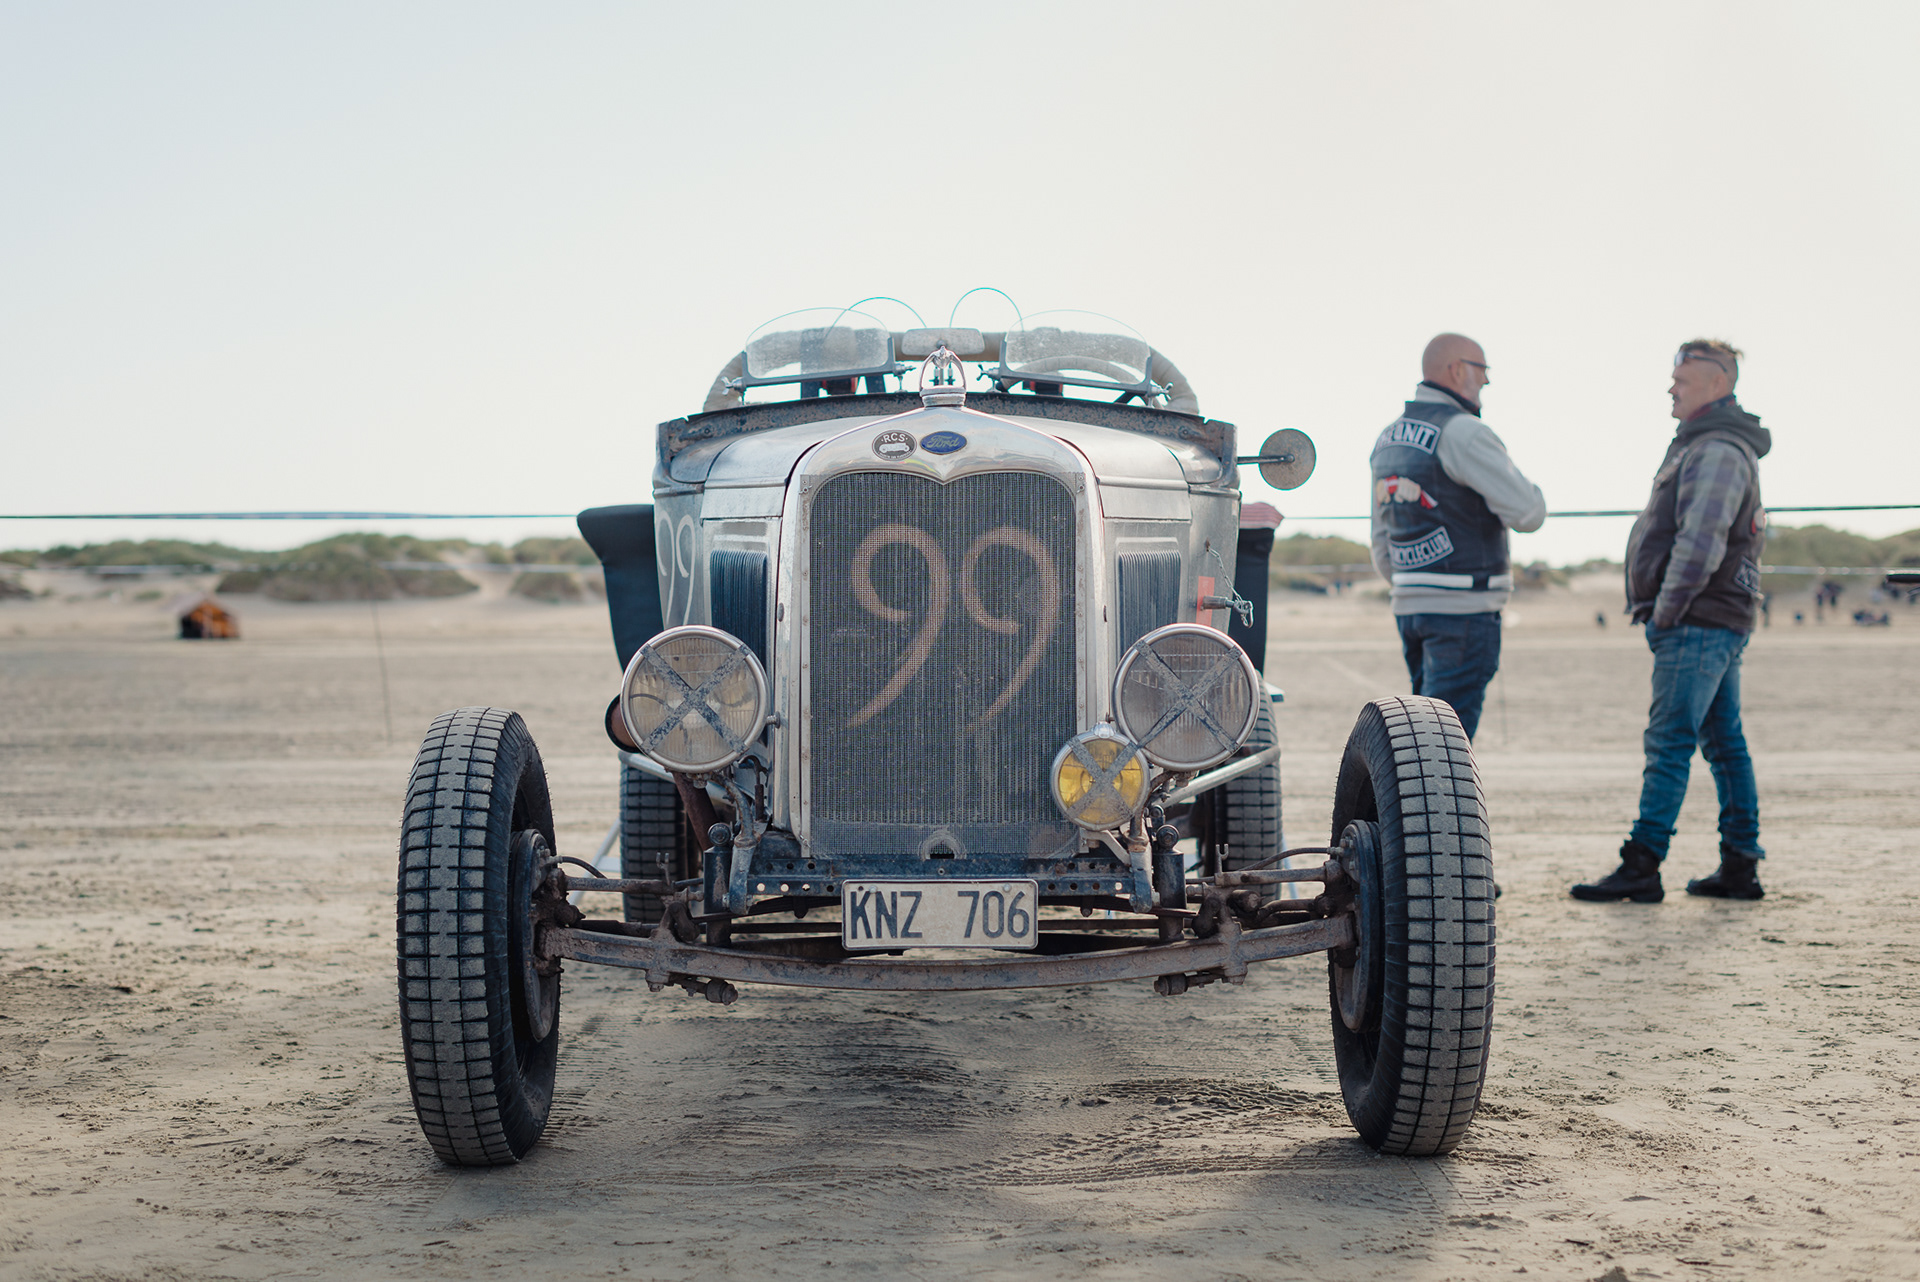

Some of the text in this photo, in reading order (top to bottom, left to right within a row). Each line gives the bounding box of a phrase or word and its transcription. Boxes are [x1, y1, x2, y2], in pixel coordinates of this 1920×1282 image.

[883, 432, 905, 443] RCS
[926, 434, 960, 449] Ford
[841, 523, 1060, 731] 99
[850, 890, 1030, 939] KNZ 706
